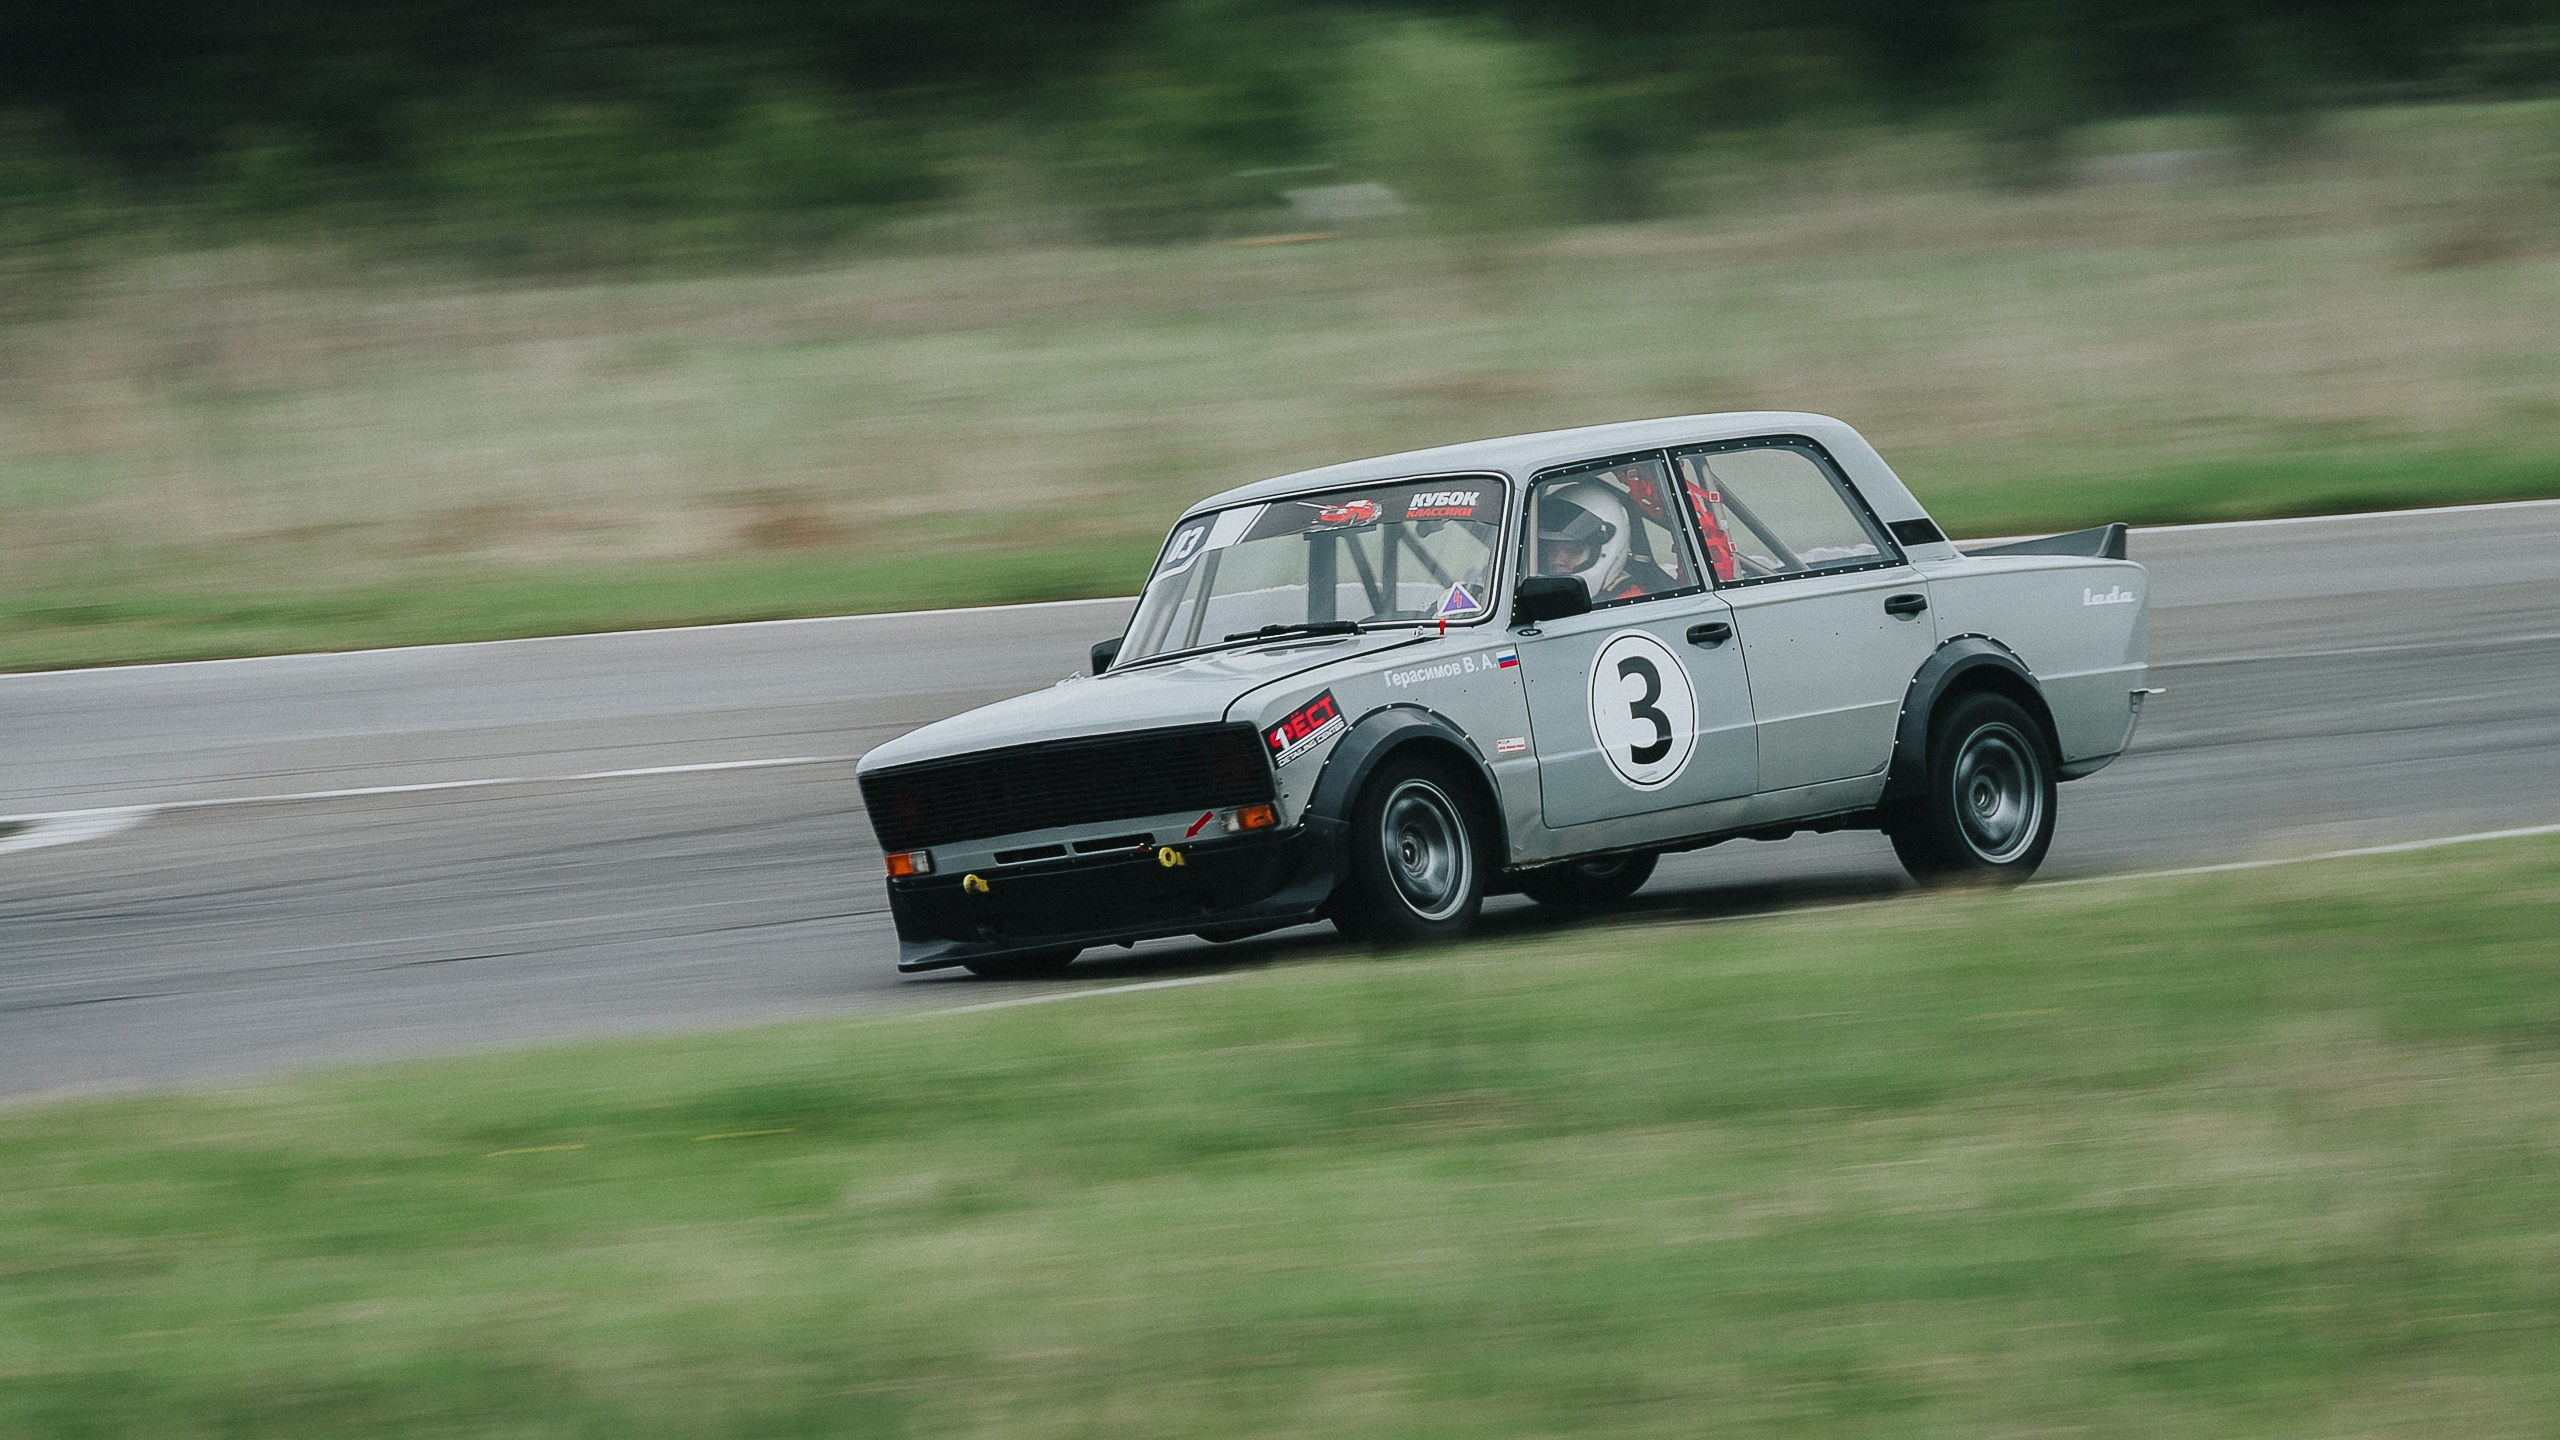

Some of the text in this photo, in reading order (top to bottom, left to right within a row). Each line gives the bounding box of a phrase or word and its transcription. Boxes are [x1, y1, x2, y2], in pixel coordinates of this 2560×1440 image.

[1405, 507, 1473, 518] КЛАССИКИ
[1408, 491, 1480, 508] КУБОК
[1166, 525, 1205, 564] 03
[1383, 653, 1498, 689] Герасимов В. А.
[1616, 656, 1674, 765] 3
[1316, 720, 1346, 743] CENTER
